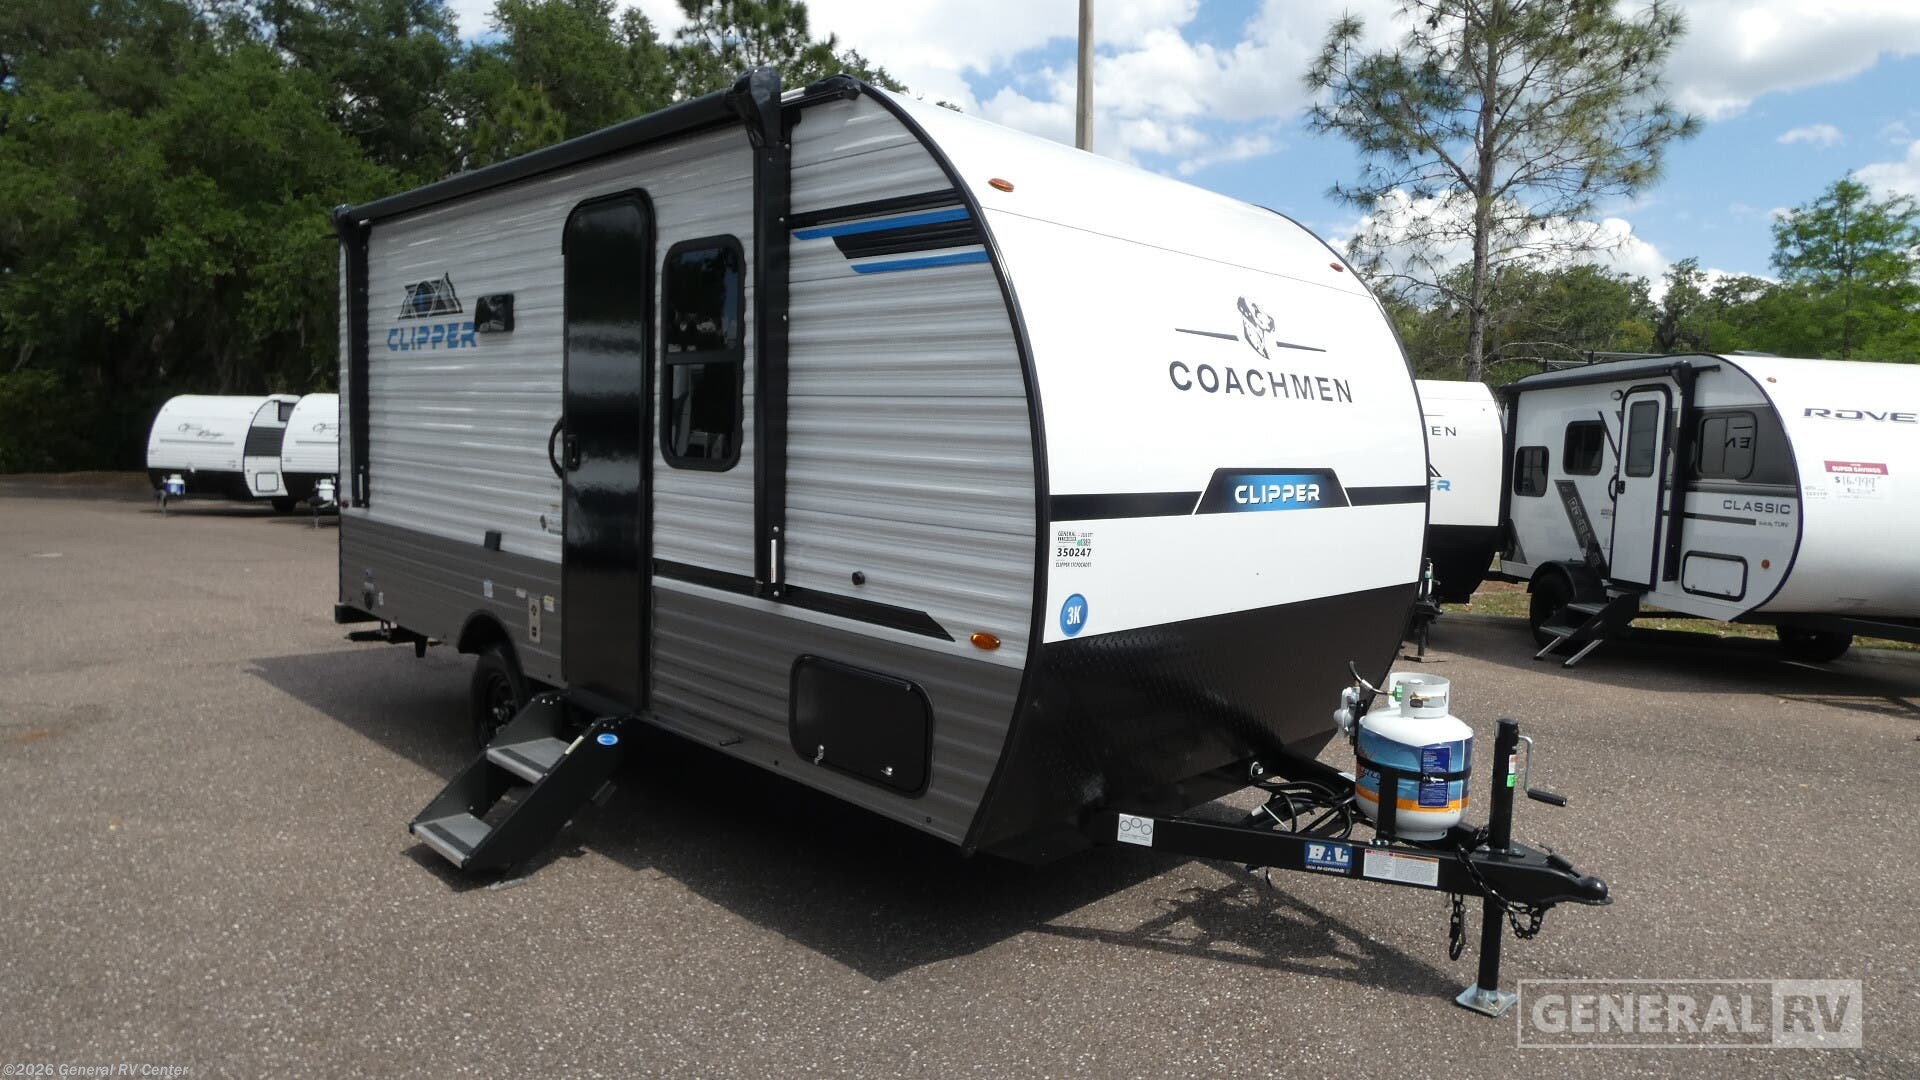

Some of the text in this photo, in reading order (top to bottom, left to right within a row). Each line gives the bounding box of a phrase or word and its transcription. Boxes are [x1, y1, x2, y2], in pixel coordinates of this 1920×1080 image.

[387, 321, 477, 351] CLIPPER
[1169, 360, 1353, 403] COACHMEN
[1803, 408, 1918, 424] ROVE
[1234, 483, 1320, 504] CLIPPER
[1723, 500, 1791, 515] CLASSIC
[1057, 547, 1092, 557] 350247
[1066, 605, 1082, 625] 3K
[1307, 844, 1349, 863] BAL
